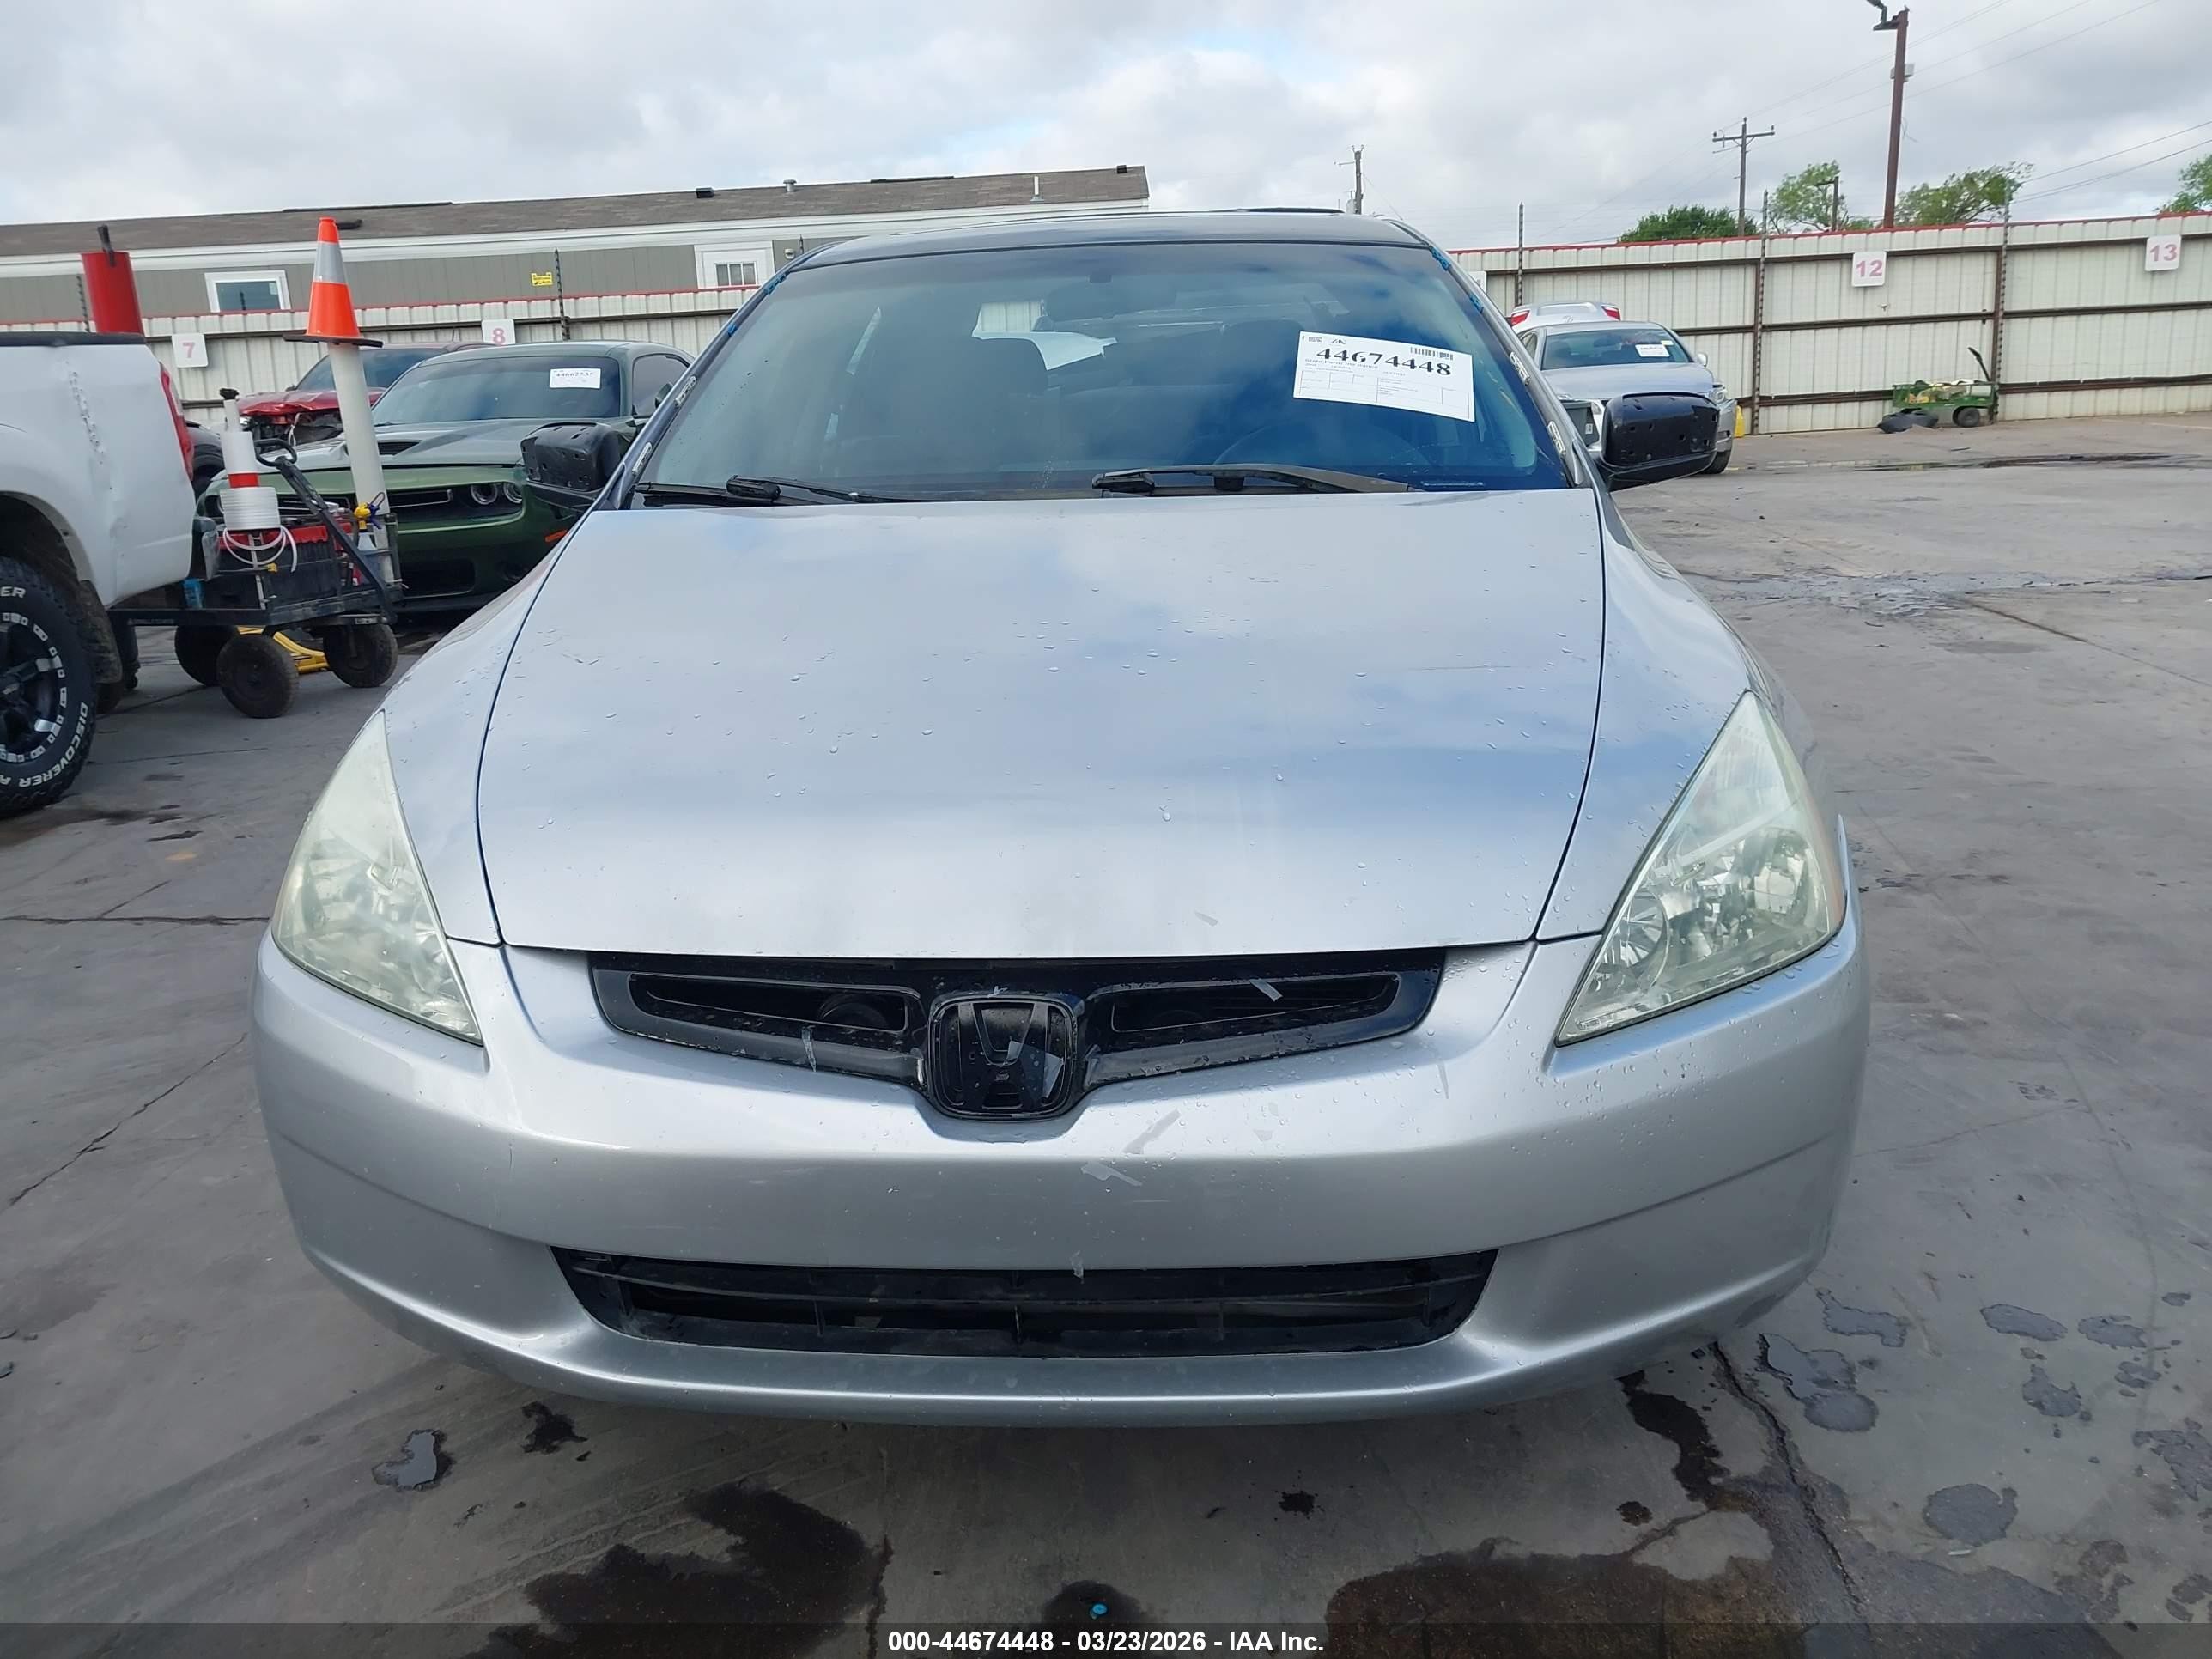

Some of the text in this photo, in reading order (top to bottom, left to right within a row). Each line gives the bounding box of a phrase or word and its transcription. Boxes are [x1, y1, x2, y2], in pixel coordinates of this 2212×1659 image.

[2149, 244, 2179, 262] 13
[1856, 259, 1884, 277] 12
[492, 328, 506, 346] 8
[182, 342, 196, 358] 7
[1316, 347, 1452, 376] 44674448
[18, 702, 89, 787] DISCOVERER
